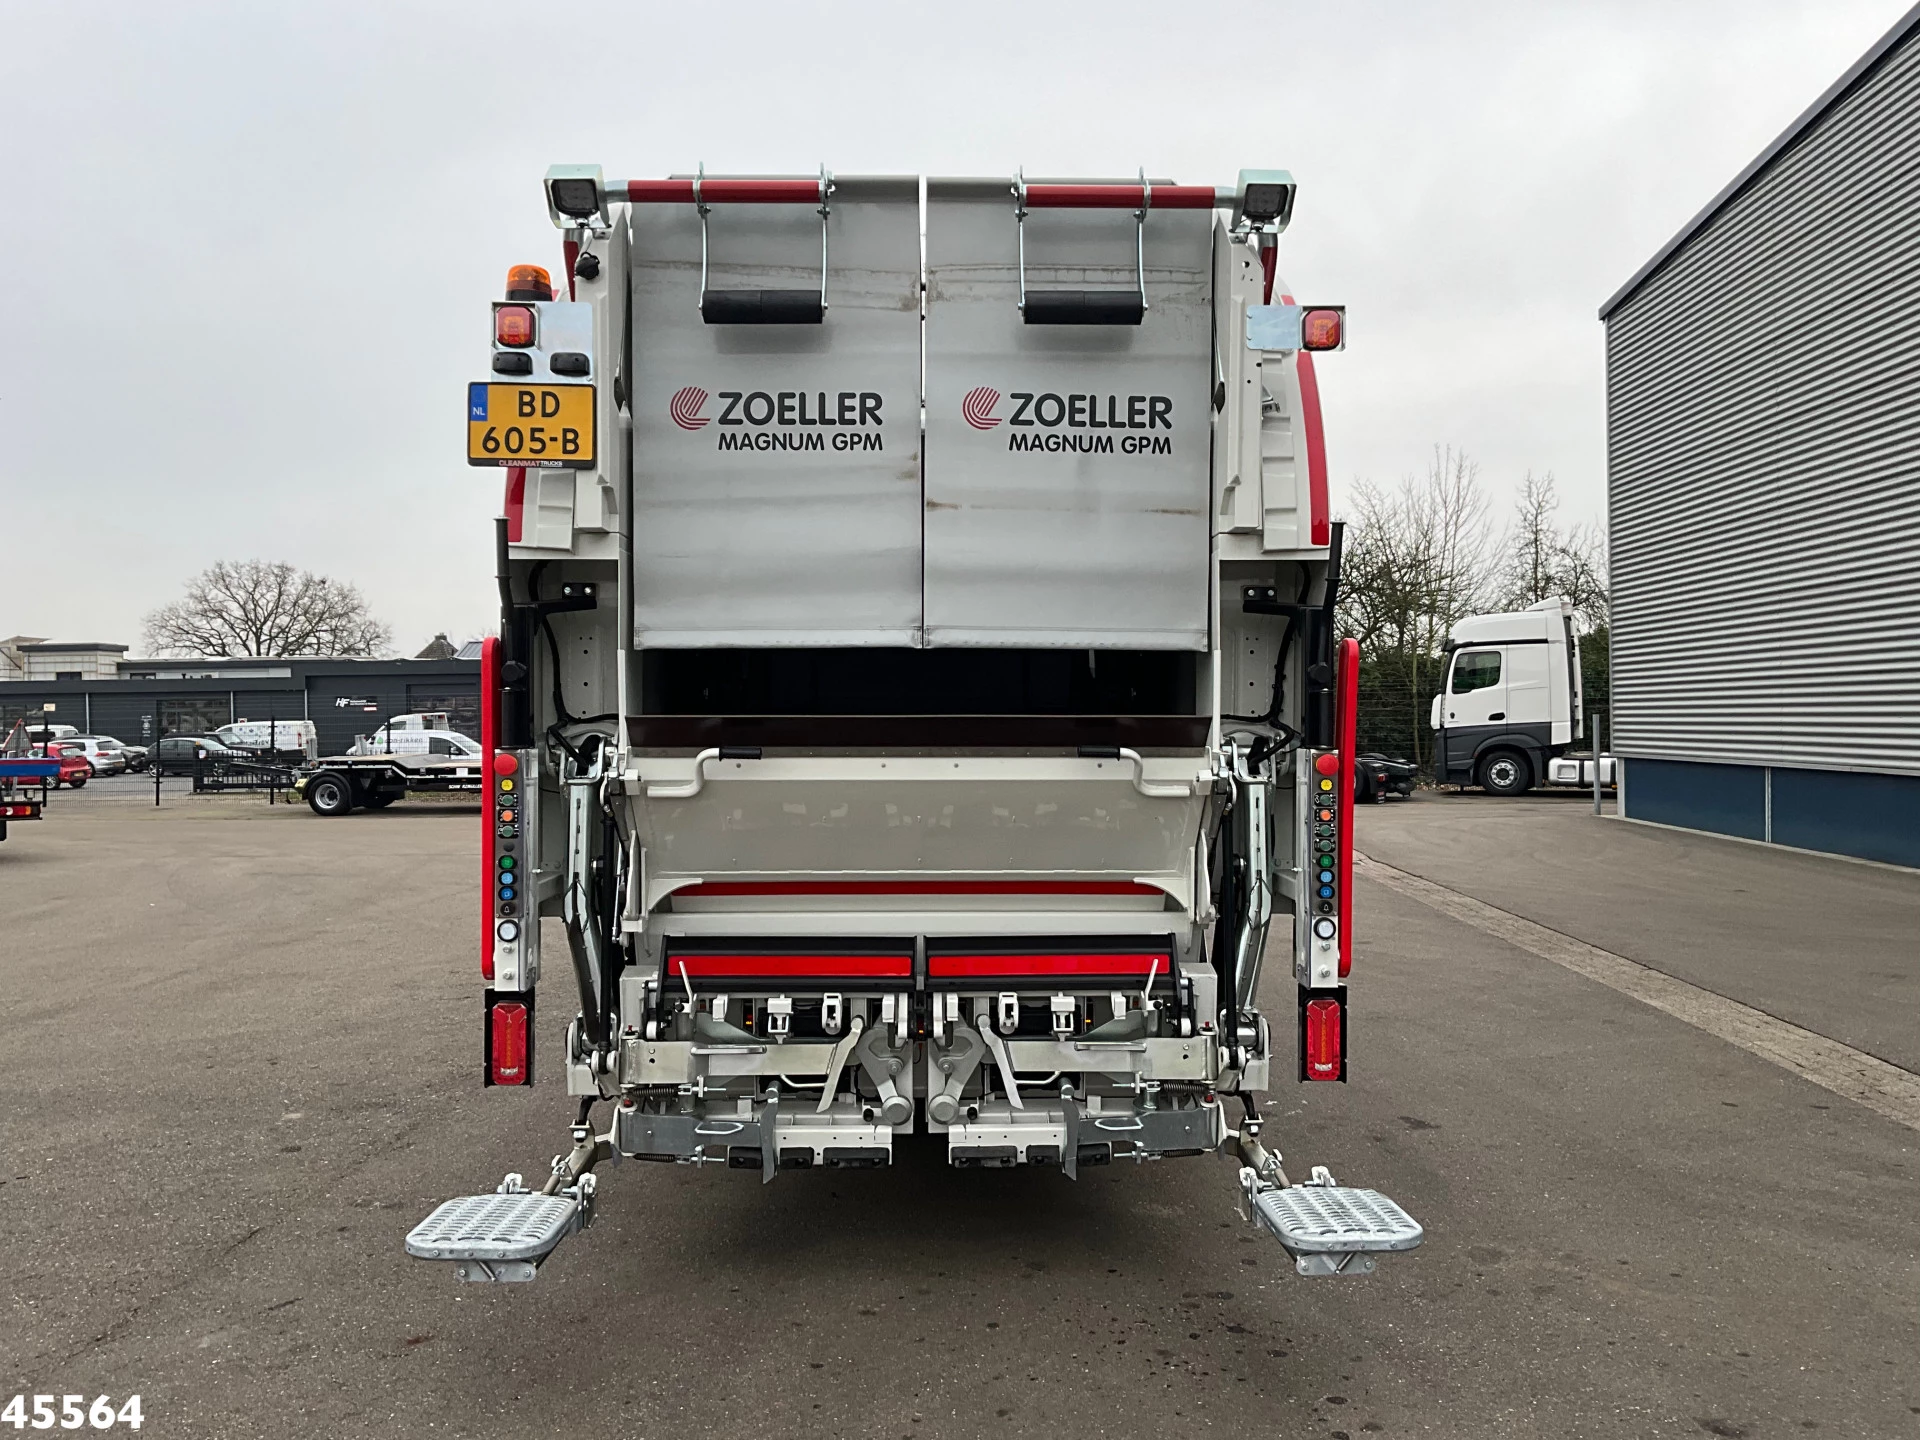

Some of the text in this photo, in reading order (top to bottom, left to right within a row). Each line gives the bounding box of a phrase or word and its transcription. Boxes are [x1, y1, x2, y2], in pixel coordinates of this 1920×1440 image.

[472, 406, 486, 416] NL
[518, 390, 560, 418] BD
[718, 391, 883, 426] ZOELLER
[1009, 392, 1173, 430] ZOELLER
[482, 426, 580, 455] 605-B
[718, 432, 883, 451] MAGNUM GPM
[1008, 433, 1172, 455] MAGNUM GPM
